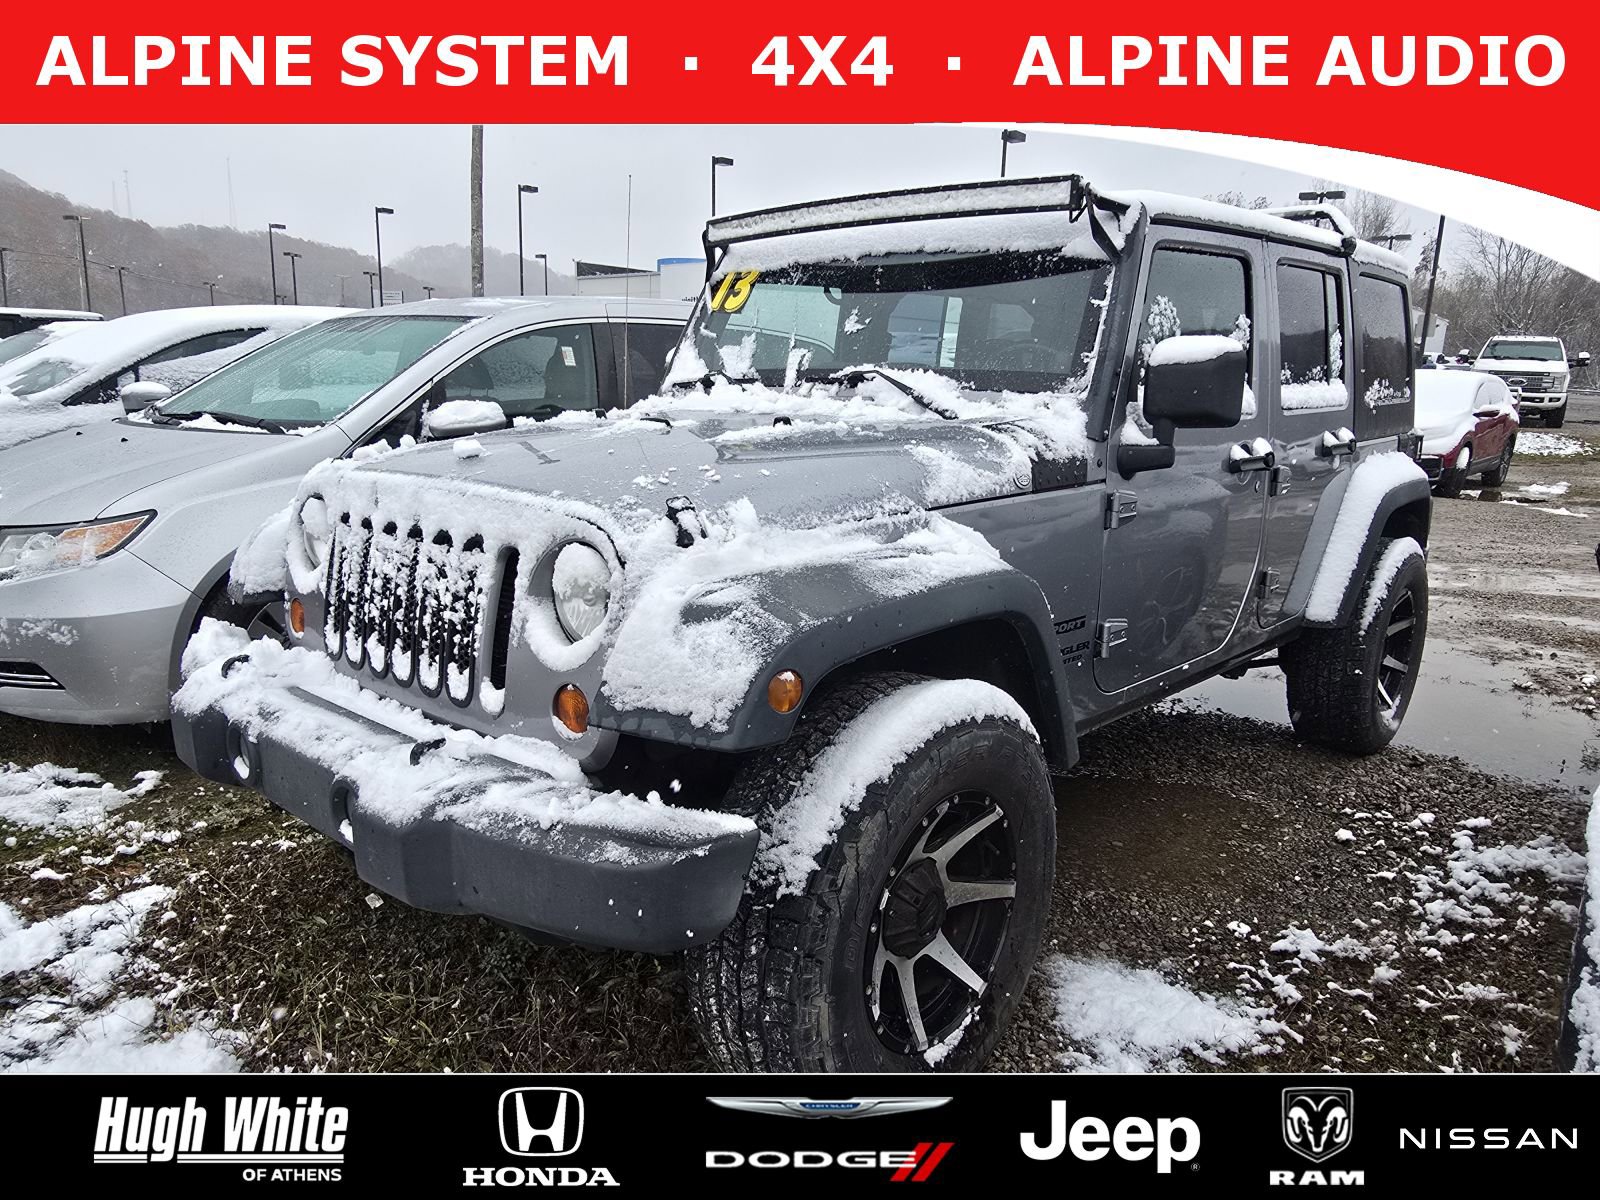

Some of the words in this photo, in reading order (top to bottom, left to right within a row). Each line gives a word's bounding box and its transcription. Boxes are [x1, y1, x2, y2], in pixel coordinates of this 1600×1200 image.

[711, 271, 760, 312] 13
[1053, 618, 1086, 633] PORT
[1060, 640, 1090, 656] GLER
